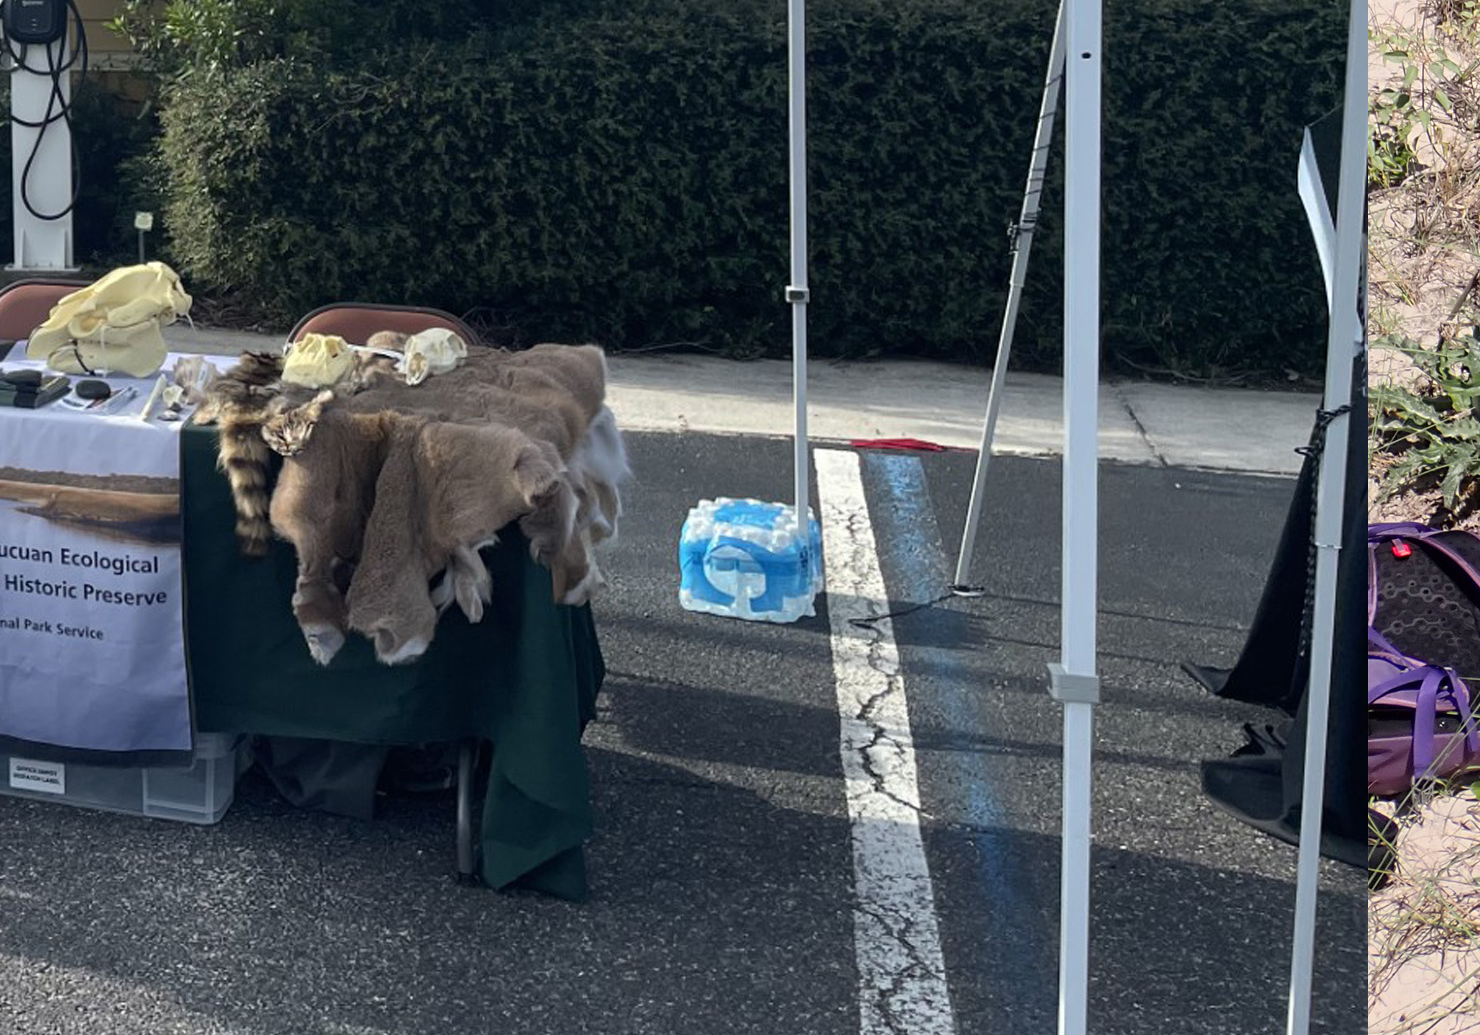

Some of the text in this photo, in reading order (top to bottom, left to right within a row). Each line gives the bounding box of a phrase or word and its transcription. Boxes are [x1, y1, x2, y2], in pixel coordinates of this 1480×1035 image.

[60, 547, 159, 575] Ecological
[4, 573, 77, 600] Historic
[83, 585, 168, 607] Preserve
[23, 618, 53, 634] Park
[56, 622, 105, 641] Service
